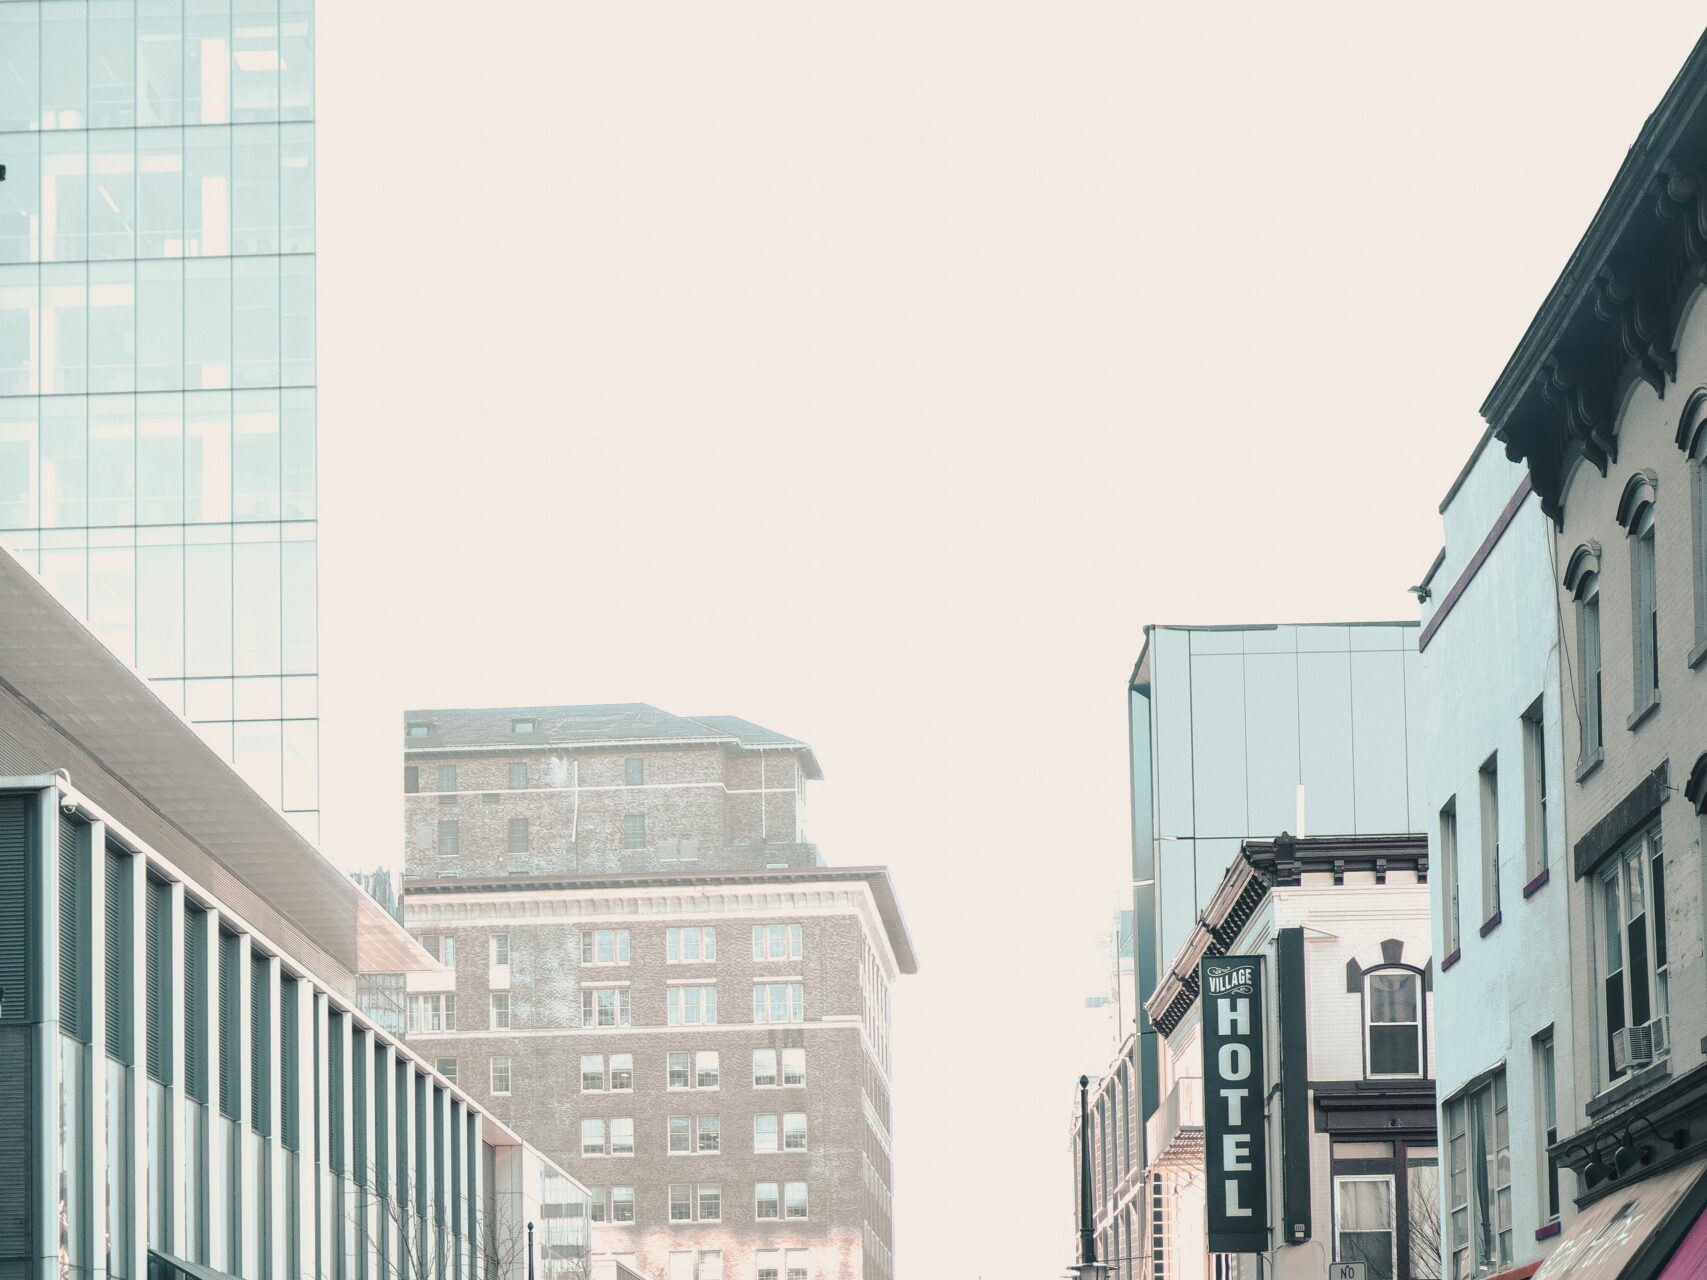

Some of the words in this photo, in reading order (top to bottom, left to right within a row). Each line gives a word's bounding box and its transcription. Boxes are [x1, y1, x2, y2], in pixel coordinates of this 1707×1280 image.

[1209, 968, 1252, 993] VILLAGE
[1217, 998, 1252, 1217] HOTEL
[1341, 1267, 1354, 1279] NO
